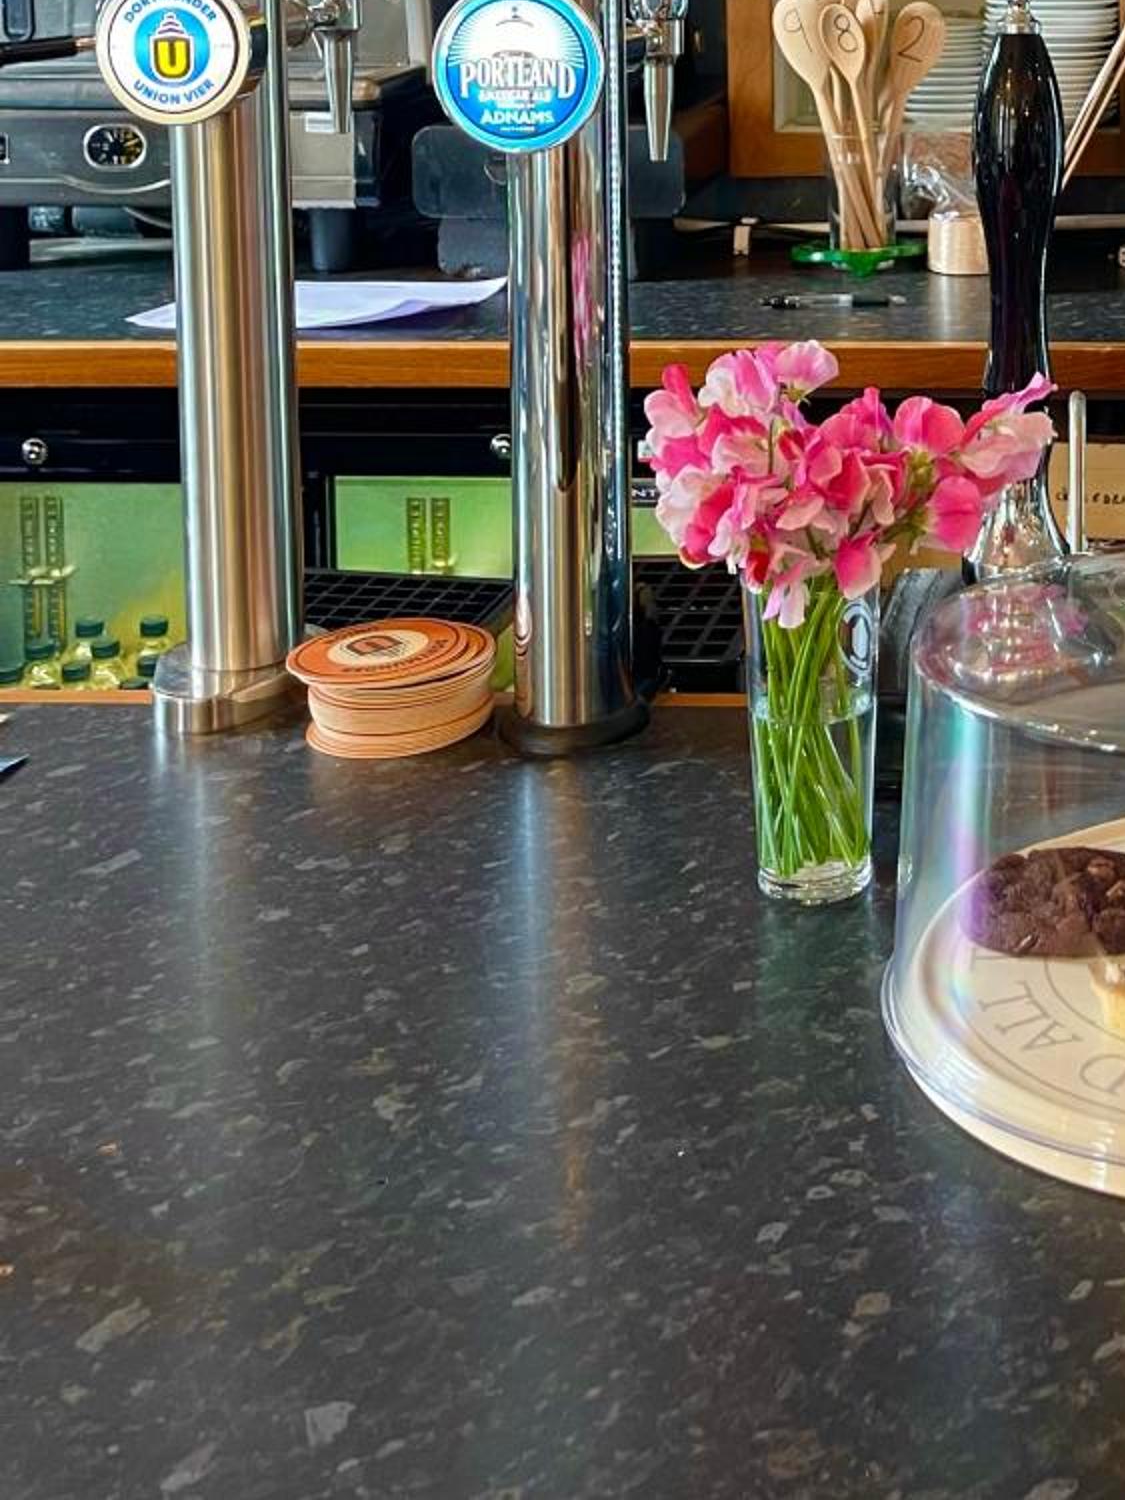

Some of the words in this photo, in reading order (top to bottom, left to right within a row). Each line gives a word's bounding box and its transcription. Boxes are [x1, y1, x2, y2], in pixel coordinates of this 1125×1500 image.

[833, 15, 858, 53] 8
[897, 16, 926, 63] 2
[156, 39, 189, 77] U
[133, 79, 181, 105] UNION
[184, 78, 215, 103] VIER
[460, 56, 577, 99] PORTLAND
[480, 108, 554, 125] ADNAMS
[978, 980, 1084, 1052] ALL
